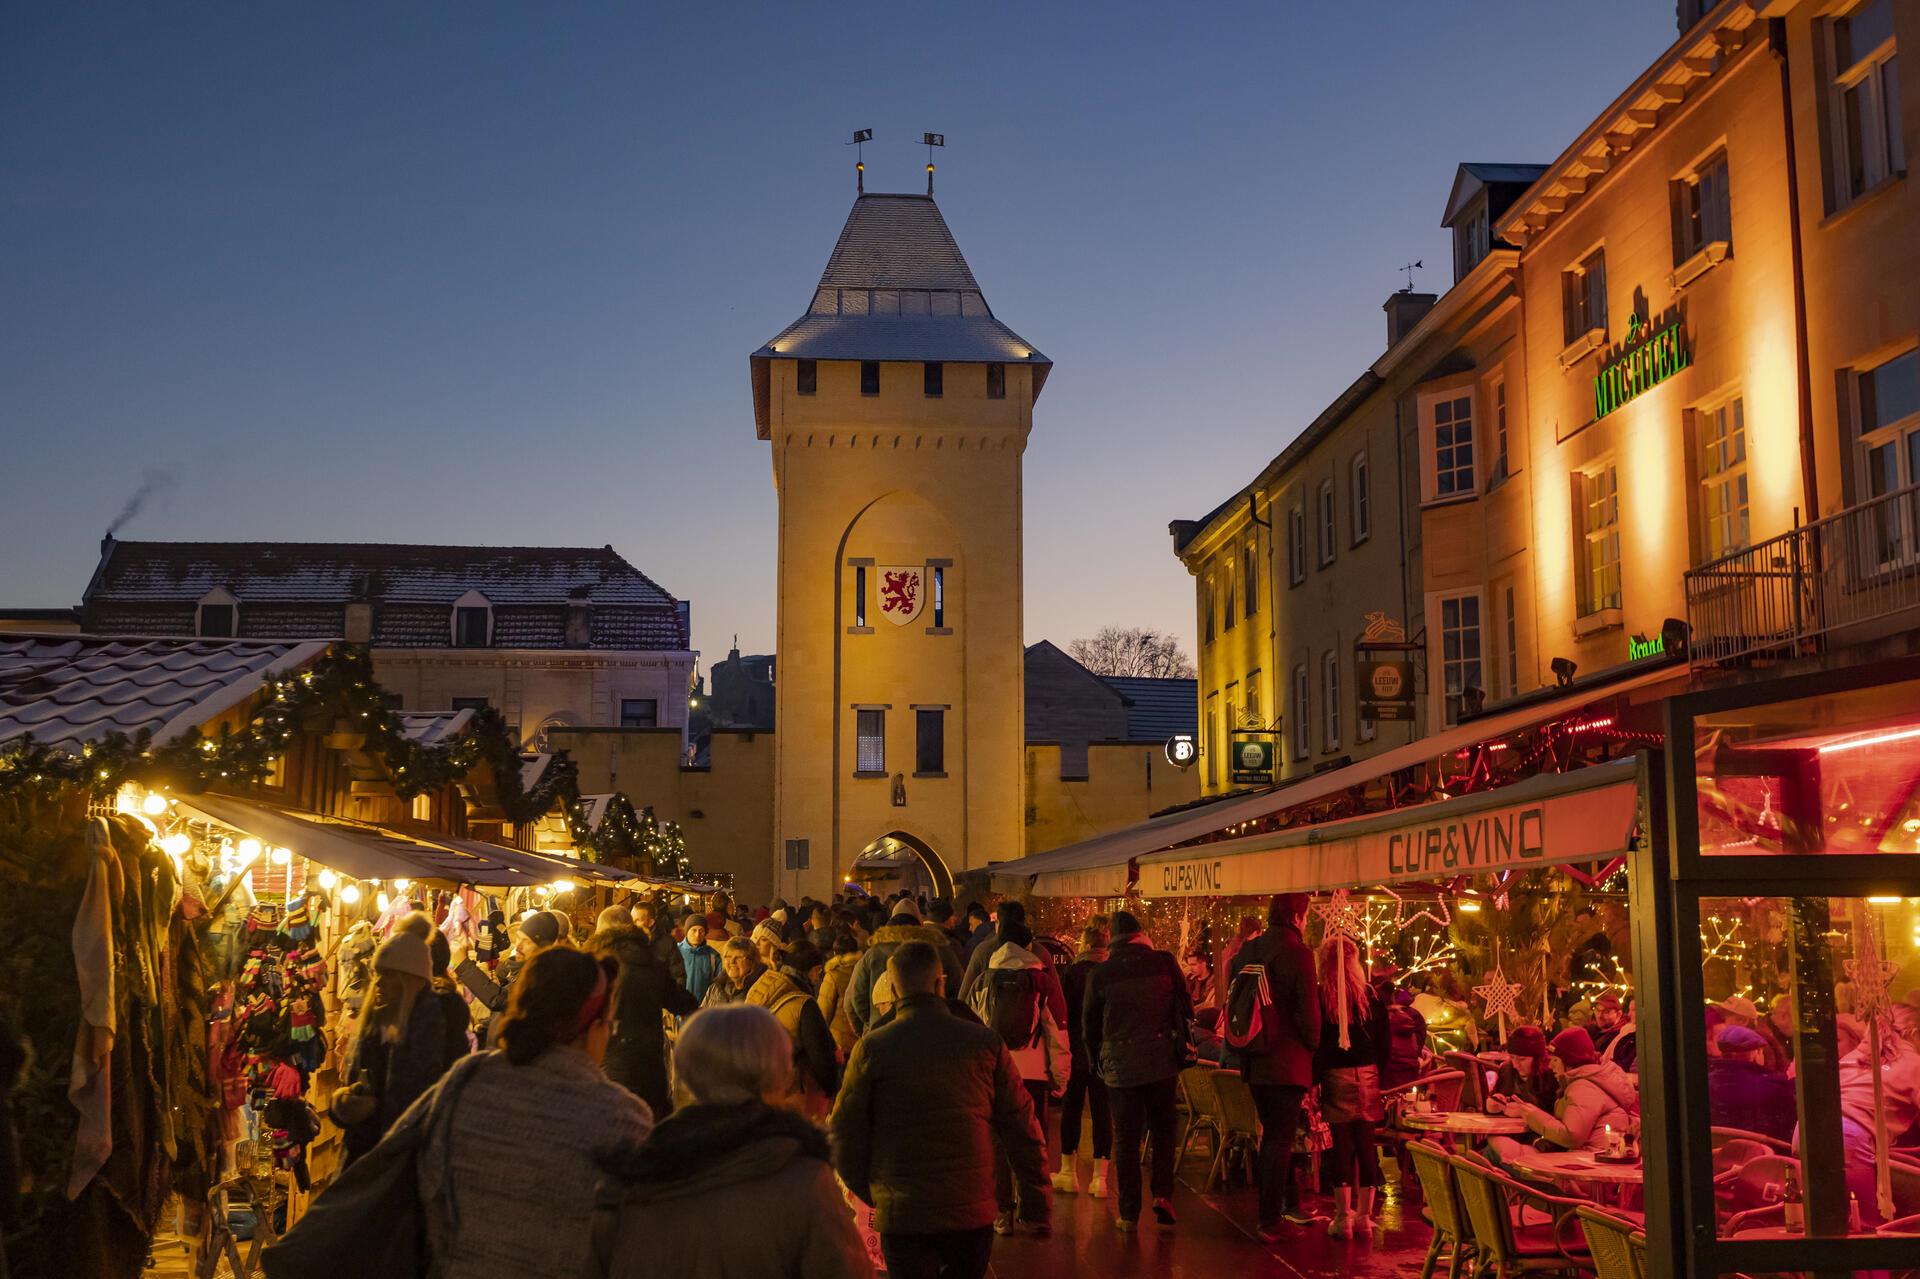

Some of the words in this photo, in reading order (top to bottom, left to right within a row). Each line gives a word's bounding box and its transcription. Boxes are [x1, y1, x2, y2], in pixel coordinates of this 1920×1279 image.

[1594, 323, 1688, 422] MICHIEL
[1175, 741, 1189, 760] 8
[1389, 808, 1543, 874] CUP&VINO
